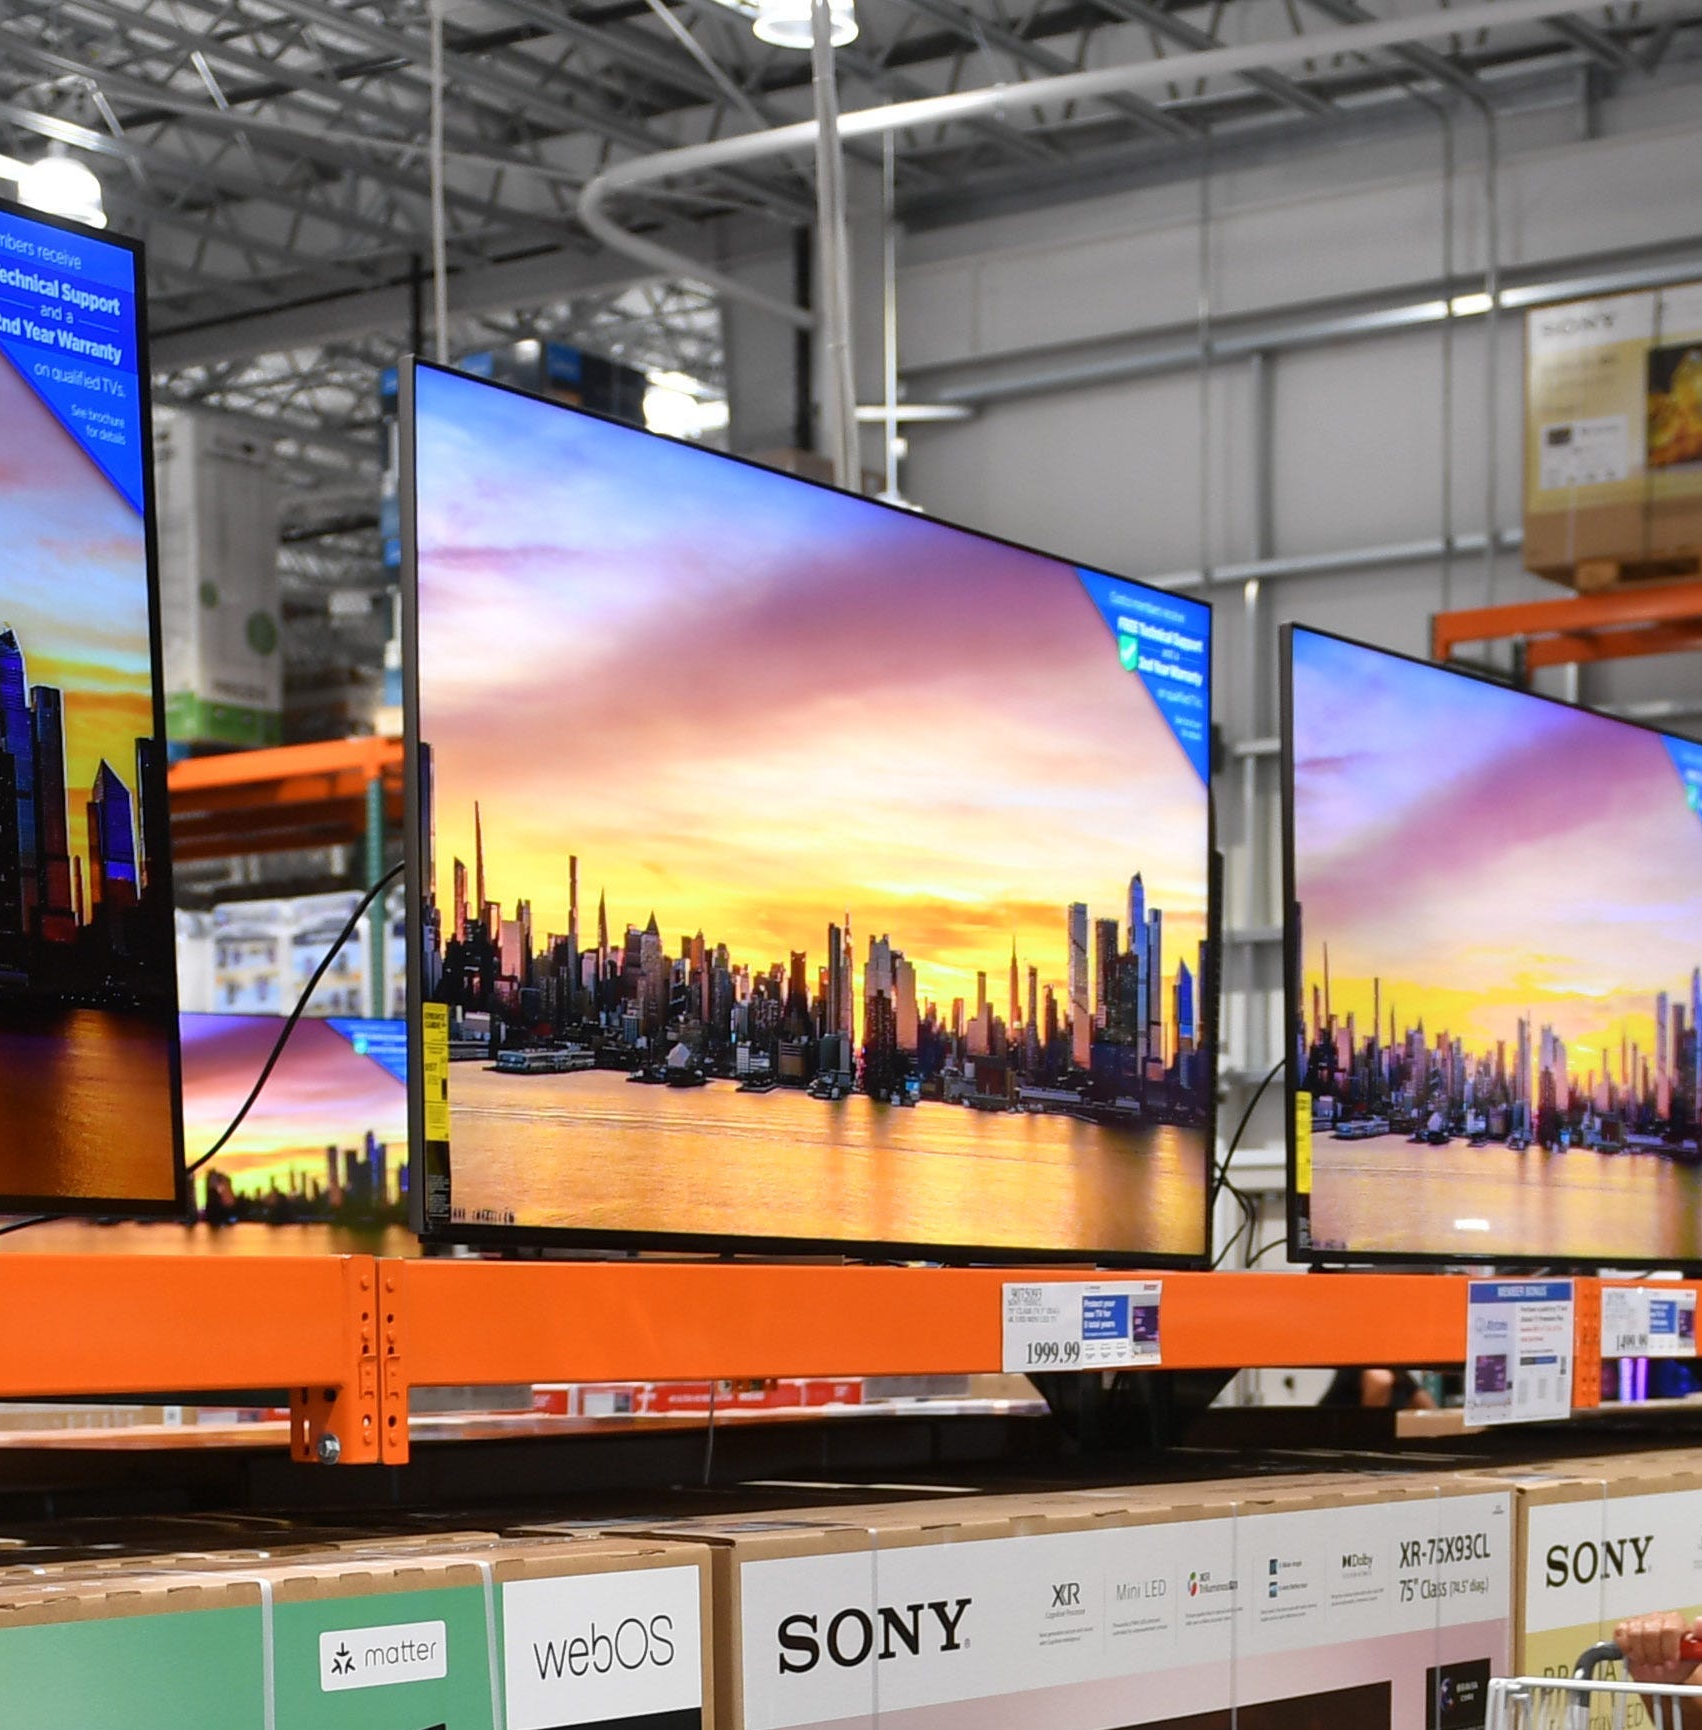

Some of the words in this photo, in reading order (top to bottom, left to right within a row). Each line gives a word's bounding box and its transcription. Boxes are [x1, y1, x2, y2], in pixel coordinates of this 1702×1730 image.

[37, 246, 82, 270] receive
[40, 302, 63, 321] and
[65, 311, 74, 324] a
[61, 283, 121, 316] Support
[23, 320, 56, 345] Year
[56, 329, 122, 366] Warranty
[34, 363, 49, 377] on
[51, 364, 100, 391] qualified
[71, 404, 87, 418] See
[88, 407, 125, 429] brochure
[86, 425, 99, 439] for
[100, 427, 126, 445] details
[1026, 1341, 1080, 1365] 1999.99
[1399, 1532, 1492, 1570] XR-75X93CL
[1546, 1534, 1654, 1589] SONY
[1116, 1583, 1141, 1602] Mini
[1144, 1579, 1167, 1600] LED
[1421, 1576, 1448, 1599] Class
[533, 1615, 675, 1680] webOS
[777, 1598, 972, 1674] SONY
[364, 1640, 437, 1667] matter
